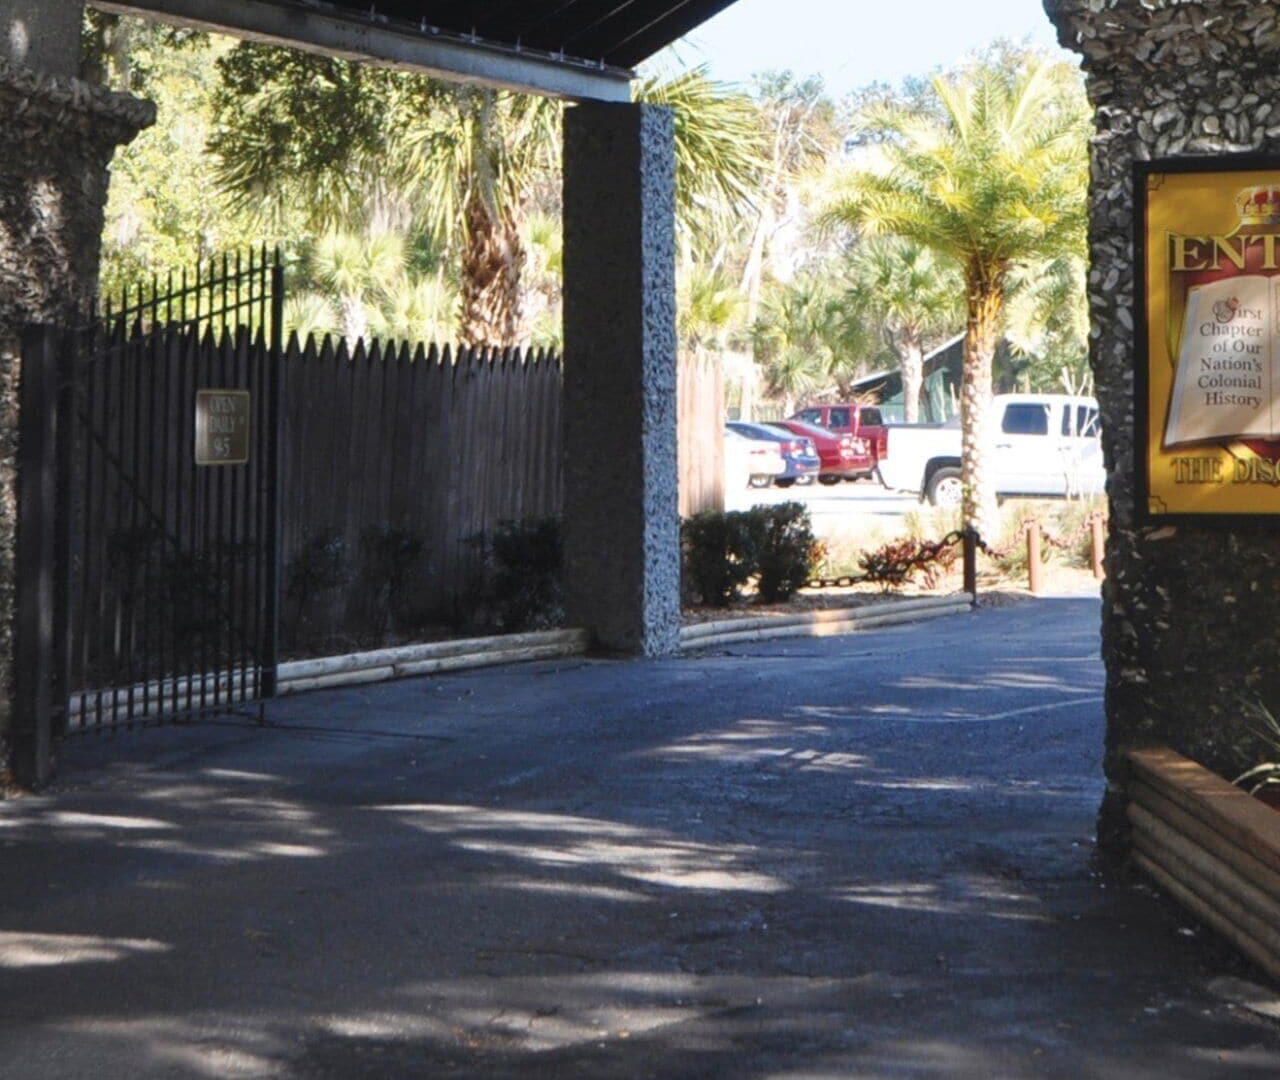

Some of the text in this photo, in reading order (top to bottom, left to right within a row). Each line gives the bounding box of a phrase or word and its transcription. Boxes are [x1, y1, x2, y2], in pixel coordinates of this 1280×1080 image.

[1200, 322, 1264, 338] Chapter
[1212, 339, 1263, 355] of Our
[1200, 356, 1264, 373] Nation's
[1197, 372, 1263, 389] Colonial
[1204, 389, 1263, 410] History
[1171, 457, 1224, 484] THE
